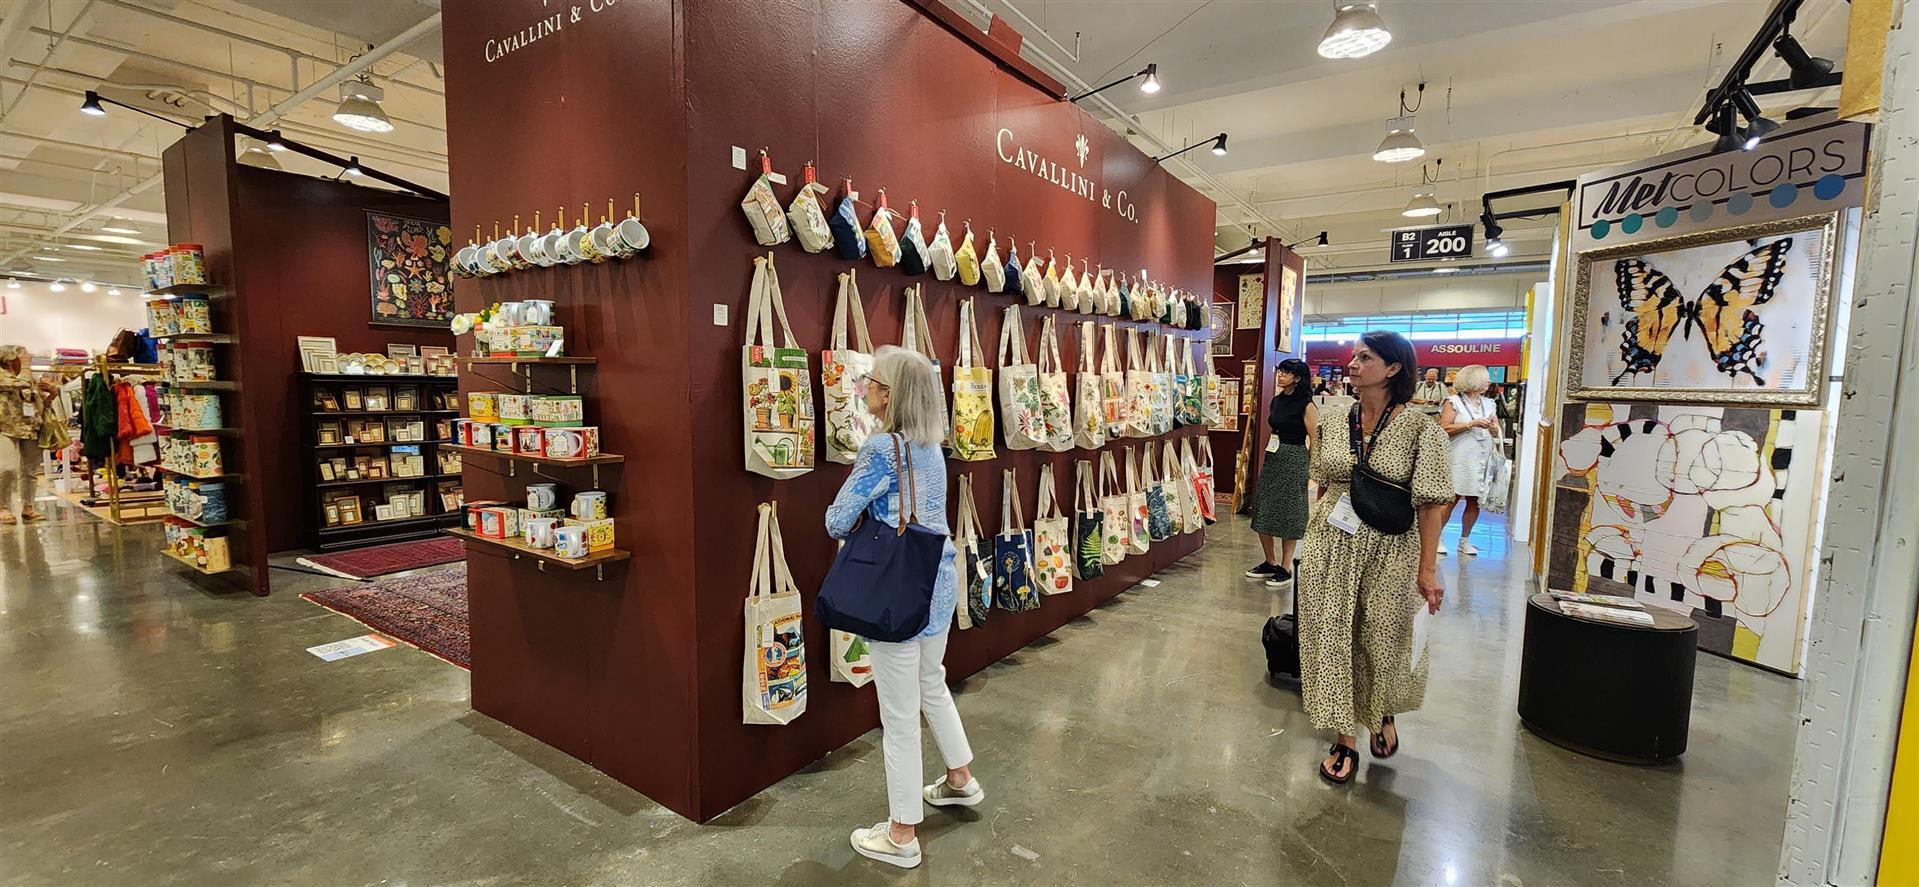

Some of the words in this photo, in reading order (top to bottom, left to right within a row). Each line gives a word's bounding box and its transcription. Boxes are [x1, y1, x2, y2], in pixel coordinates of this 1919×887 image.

[485, 13, 562, 63] CAVALLINI
[570, 5, 582, 24] &
[996, 127, 1096, 201] CAVALLINI
[1102, 188, 1112, 209] &
[1402, 232, 1416, 241] B2
[1437, 230, 1457, 238] AISLE
[1426, 236, 1466, 255] 200
[1403, 248, 1410, 259] 1
[1430, 343, 1501, 353] ASSOULINE
